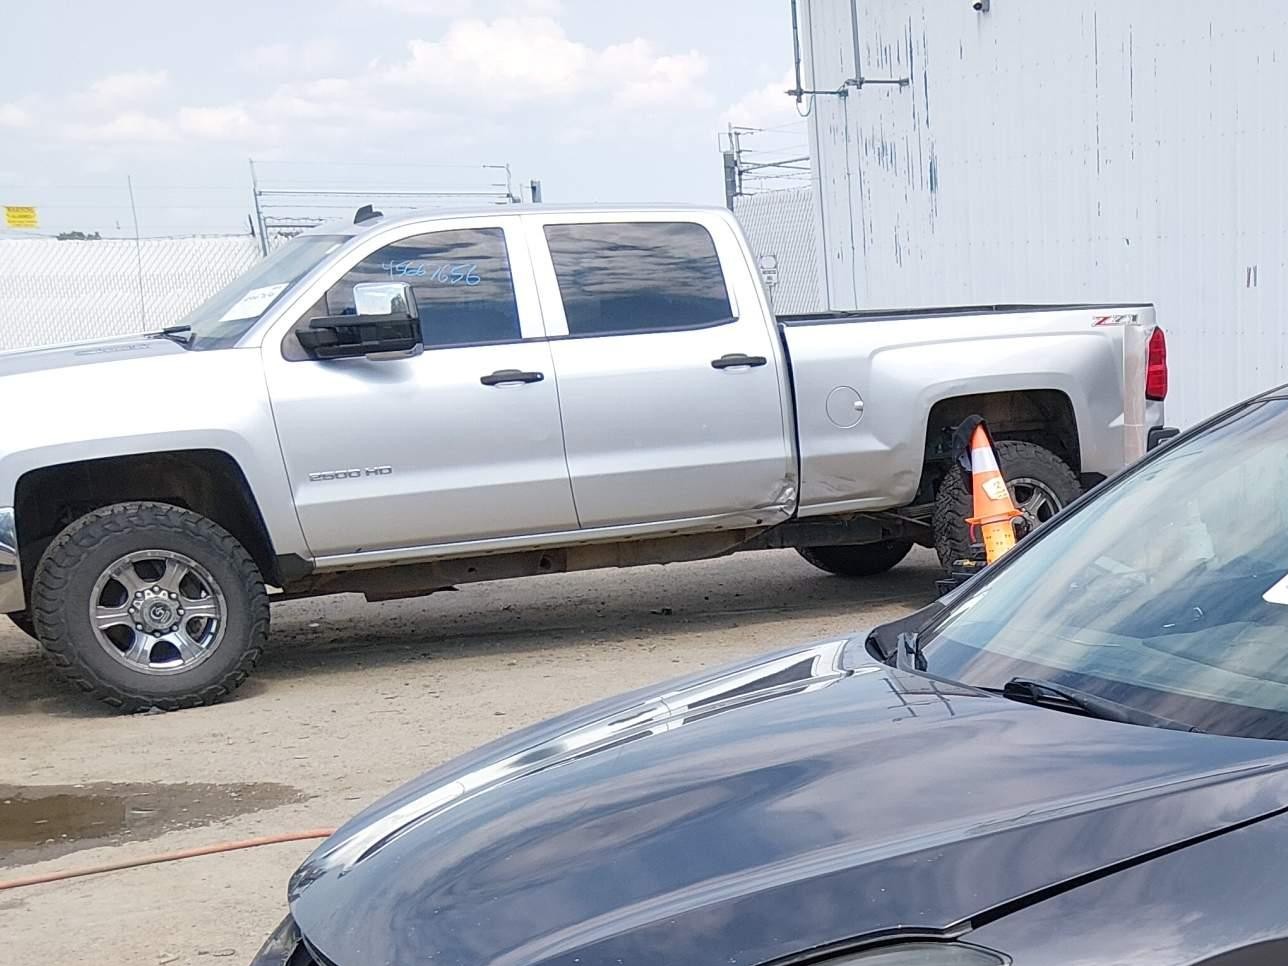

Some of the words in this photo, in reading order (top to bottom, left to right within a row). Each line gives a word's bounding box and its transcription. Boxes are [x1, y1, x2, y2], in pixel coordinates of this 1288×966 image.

[1091, 313, 1141, 328] Z71
[308, 468, 361, 482] 2500
[364, 465, 393, 477] HD
